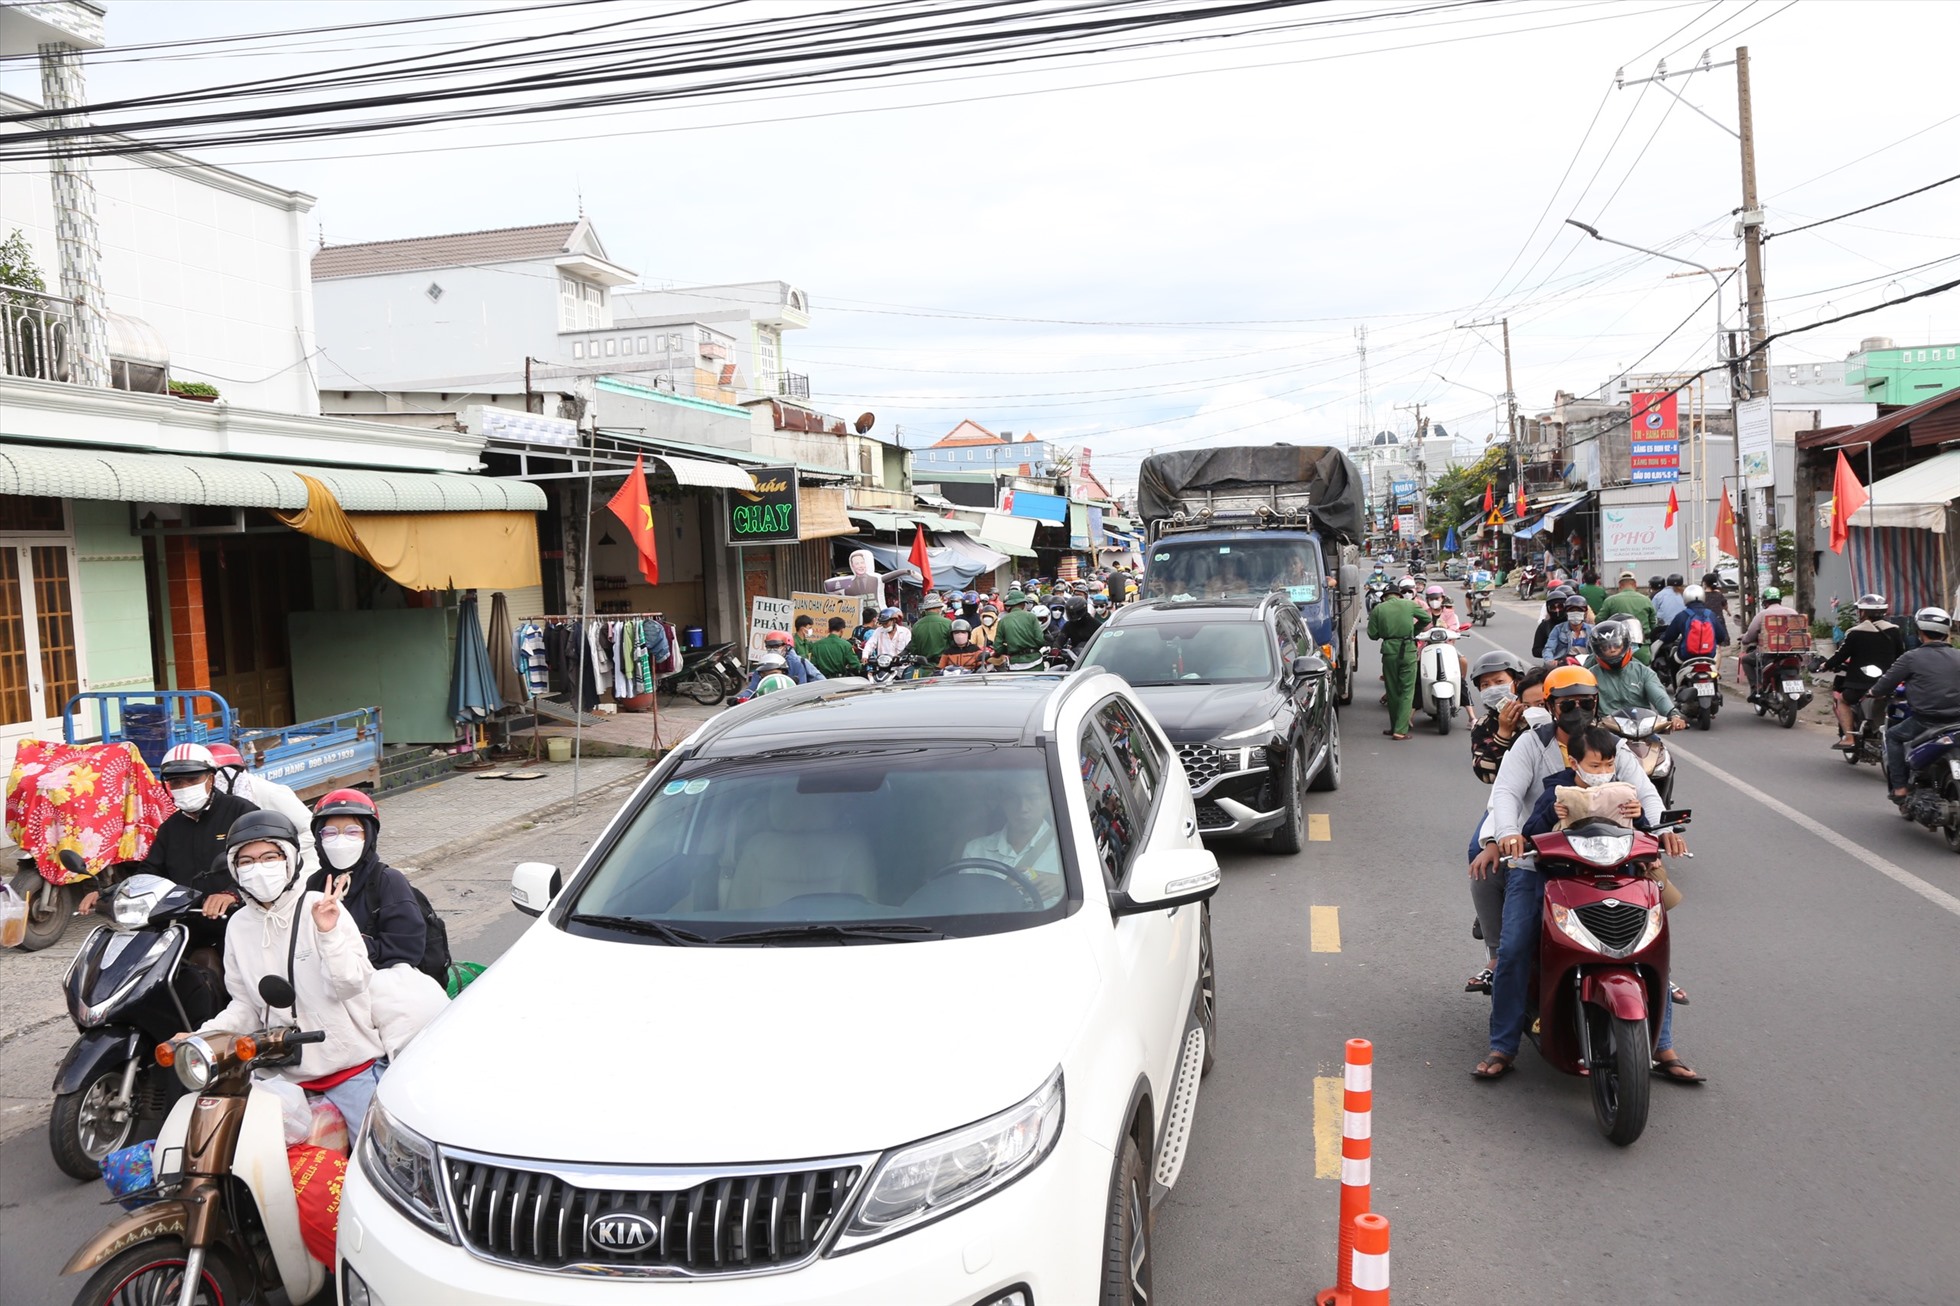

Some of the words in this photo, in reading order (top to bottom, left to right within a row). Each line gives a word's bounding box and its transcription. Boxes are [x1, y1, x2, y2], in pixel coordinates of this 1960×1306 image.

[733, 503, 792, 534] CHAY
[1611, 526, 1656, 545] PHỞ
[756, 600, 790, 615] THỰC
[754, 617, 789, 632] PHẨM
[299, 1164, 318, 1185] WELLS
[598, 1222, 646, 1244] KIA
